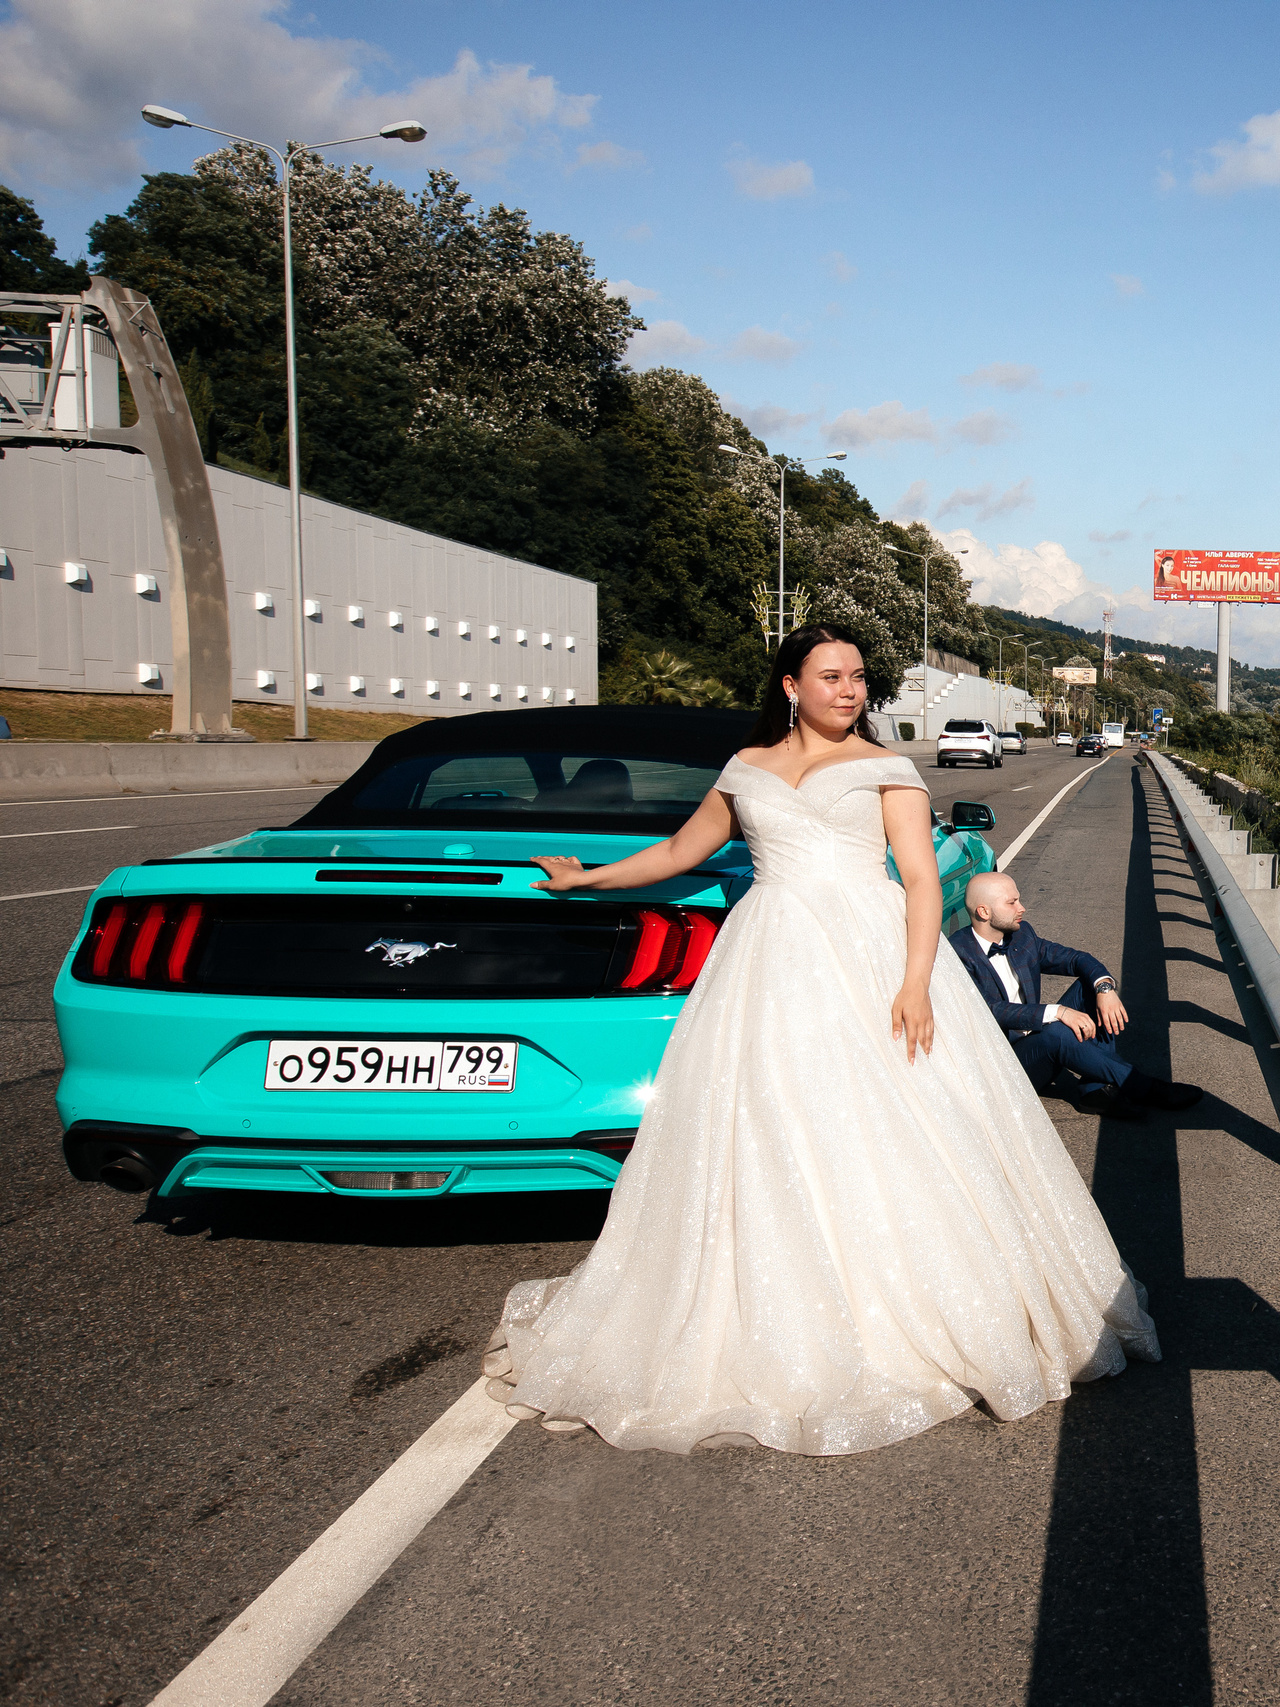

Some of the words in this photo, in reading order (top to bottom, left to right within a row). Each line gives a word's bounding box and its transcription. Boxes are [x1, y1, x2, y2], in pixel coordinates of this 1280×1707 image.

[1225, 551, 1254, 559] АВЕРБУХ
[1180, 570, 1280, 592] ЧЕМПИОНЫ
[446, 1045, 504, 1074] 799
[457, 1075, 487, 1085] RUS
